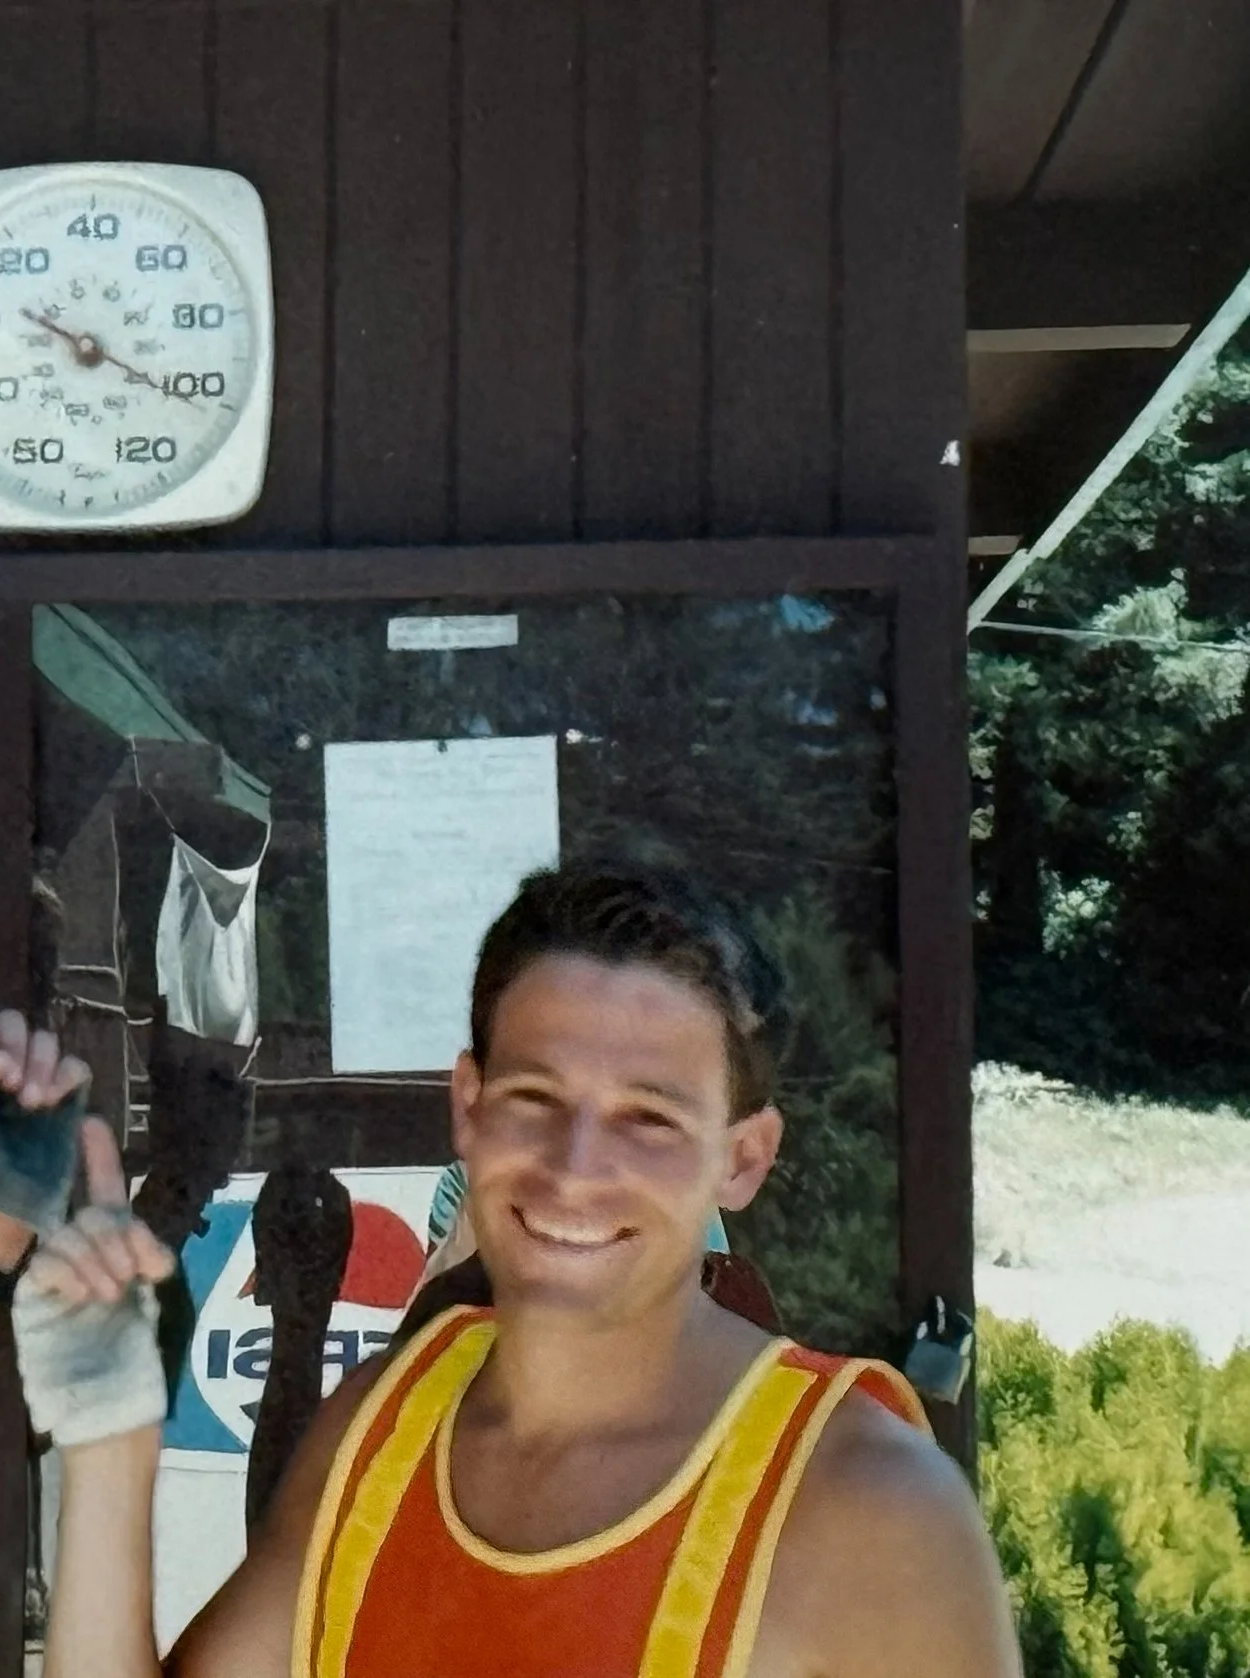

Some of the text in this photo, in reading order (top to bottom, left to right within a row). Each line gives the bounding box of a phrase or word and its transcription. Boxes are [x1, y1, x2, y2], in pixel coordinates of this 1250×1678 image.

[66, 213, 121, 240] 40
[135, 244, 188, 273] 60
[171, 303, 225, 330] 80
[162, 371, 225, 399] 100
[115, 436, 177, 465] 120
